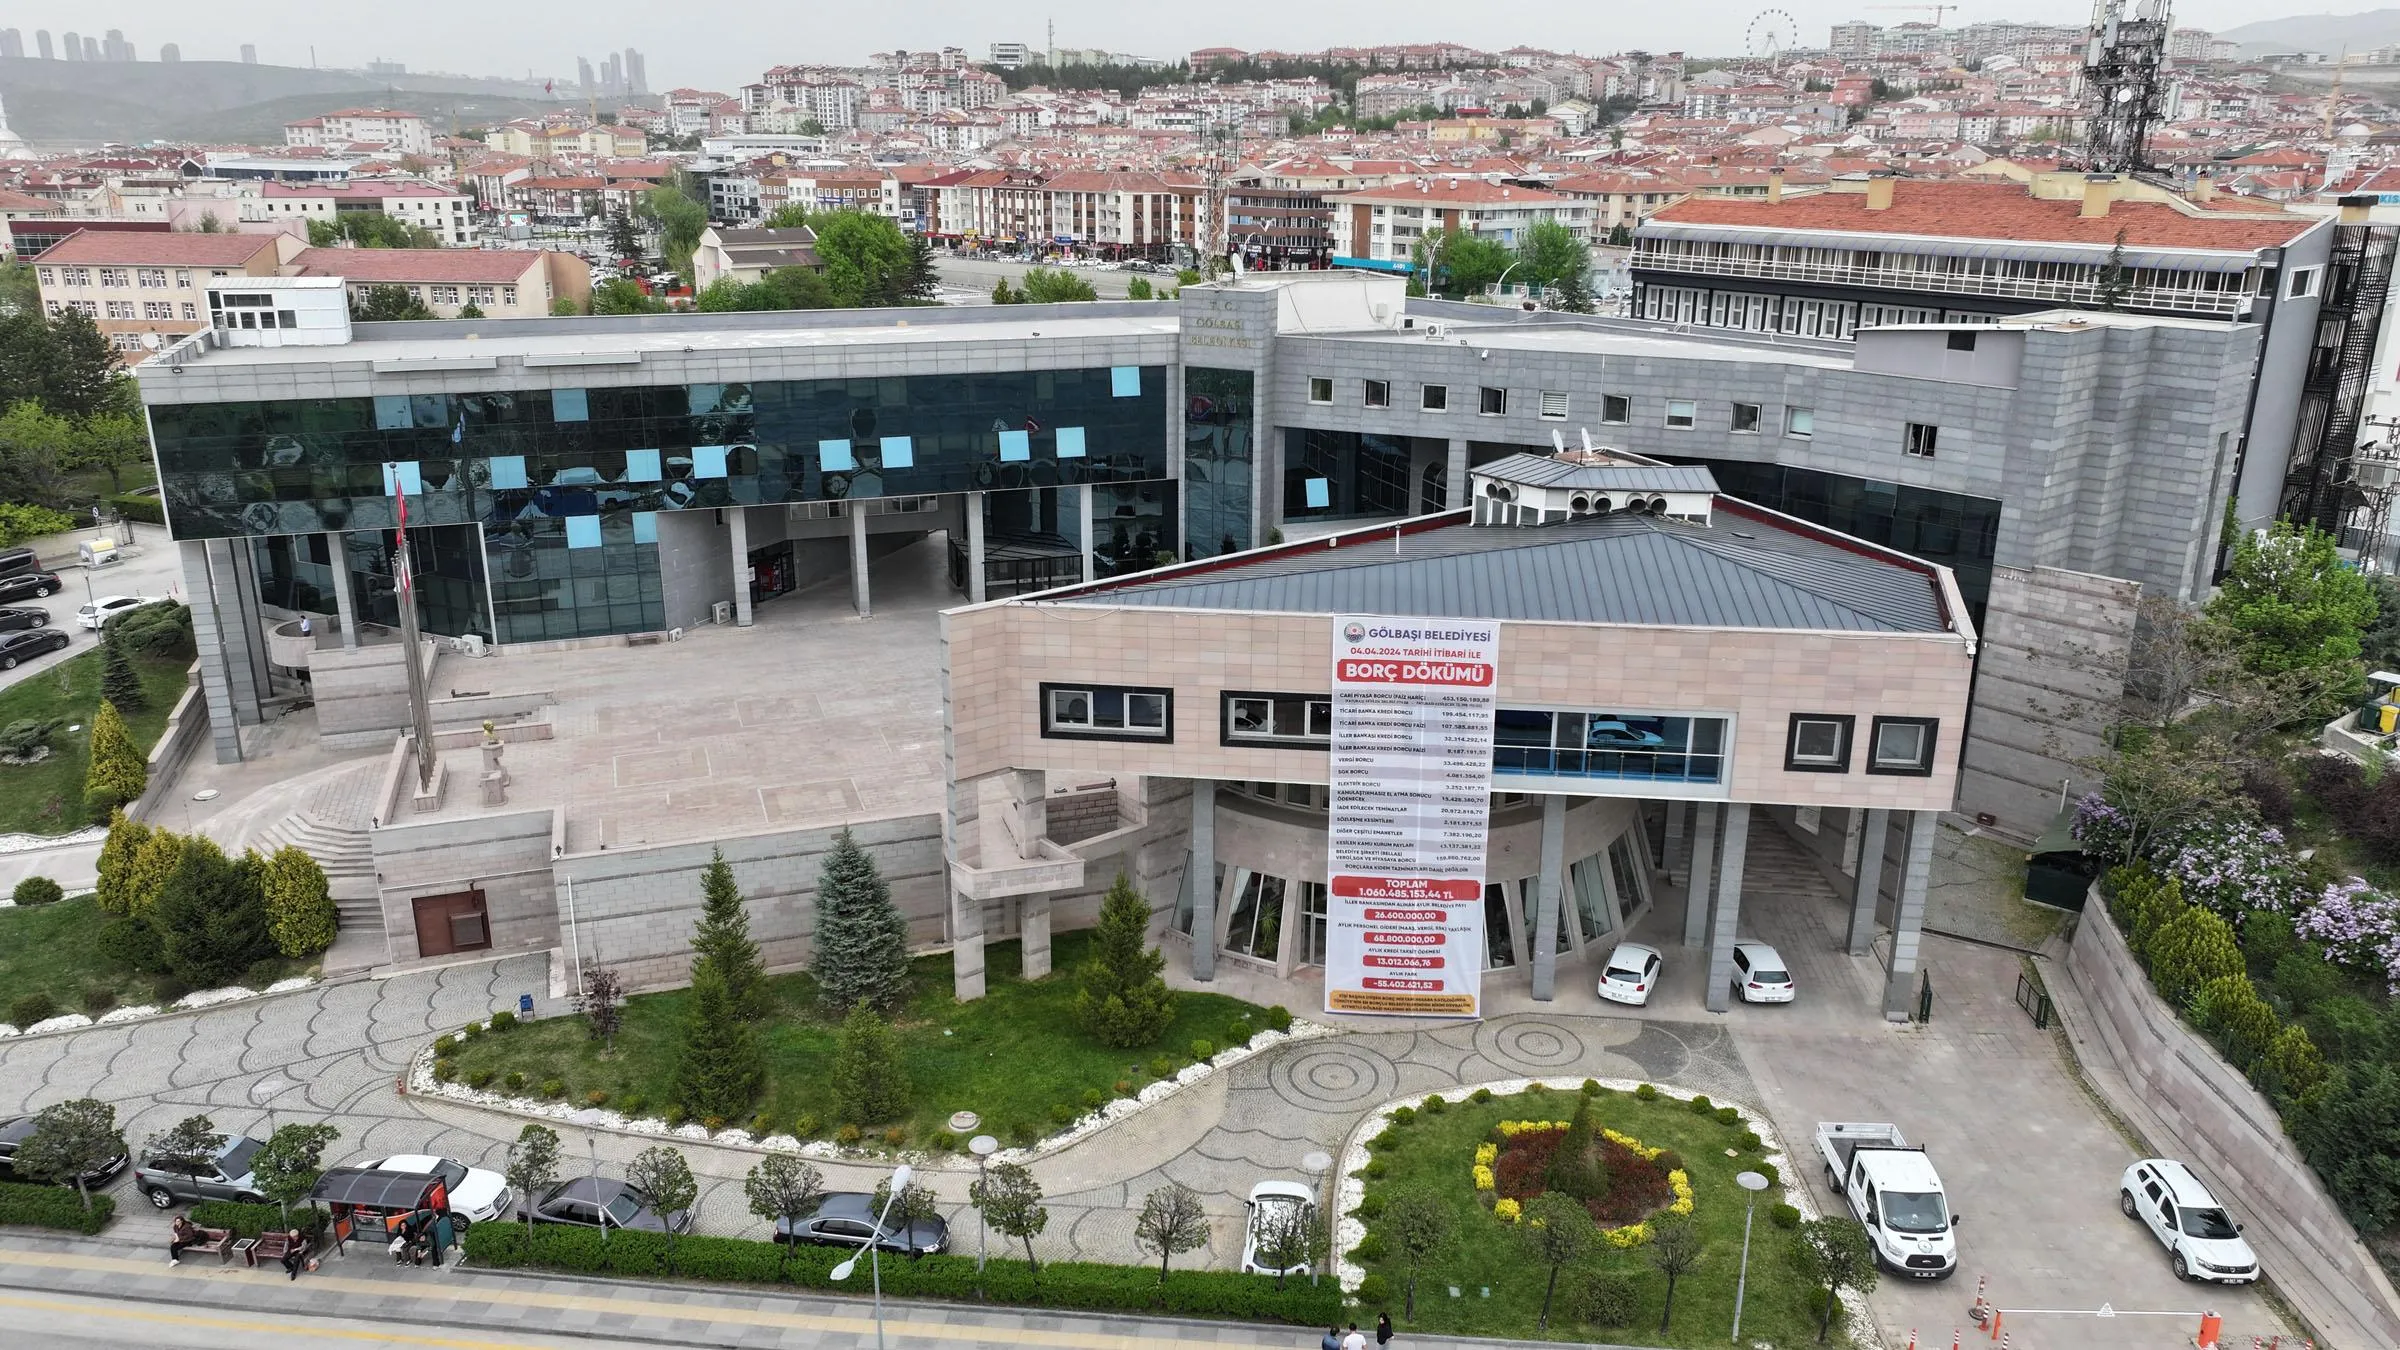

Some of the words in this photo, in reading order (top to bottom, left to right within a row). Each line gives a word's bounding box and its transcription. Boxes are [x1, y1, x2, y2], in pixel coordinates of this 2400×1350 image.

[1369, 626, 1420, 642] GÖLBAŞI
[1424, 629, 1490, 642] BELEDİYESİ
[1350, 648, 1400, 656] 04.04.2024
[1402, 648, 1432, 656] TARİHİ
[1434, 648, 1466, 658] İTİBARİ
[1468, 650, 1480, 658] İLE
[1346, 663, 1398, 682] BORÇ
[1402, 662, 1484, 682] DÖKÜMÜ
[1386, 880, 1428, 888] TOPLAM
[1375, 912, 1436, 920] 26.600.000,00
[1374, 935, 1436, 944] 68.800.000,00
[1377, 958, 1431, 967] 13.012.066,76
[1373, 981, 1433, 990] -55.402.621,52
